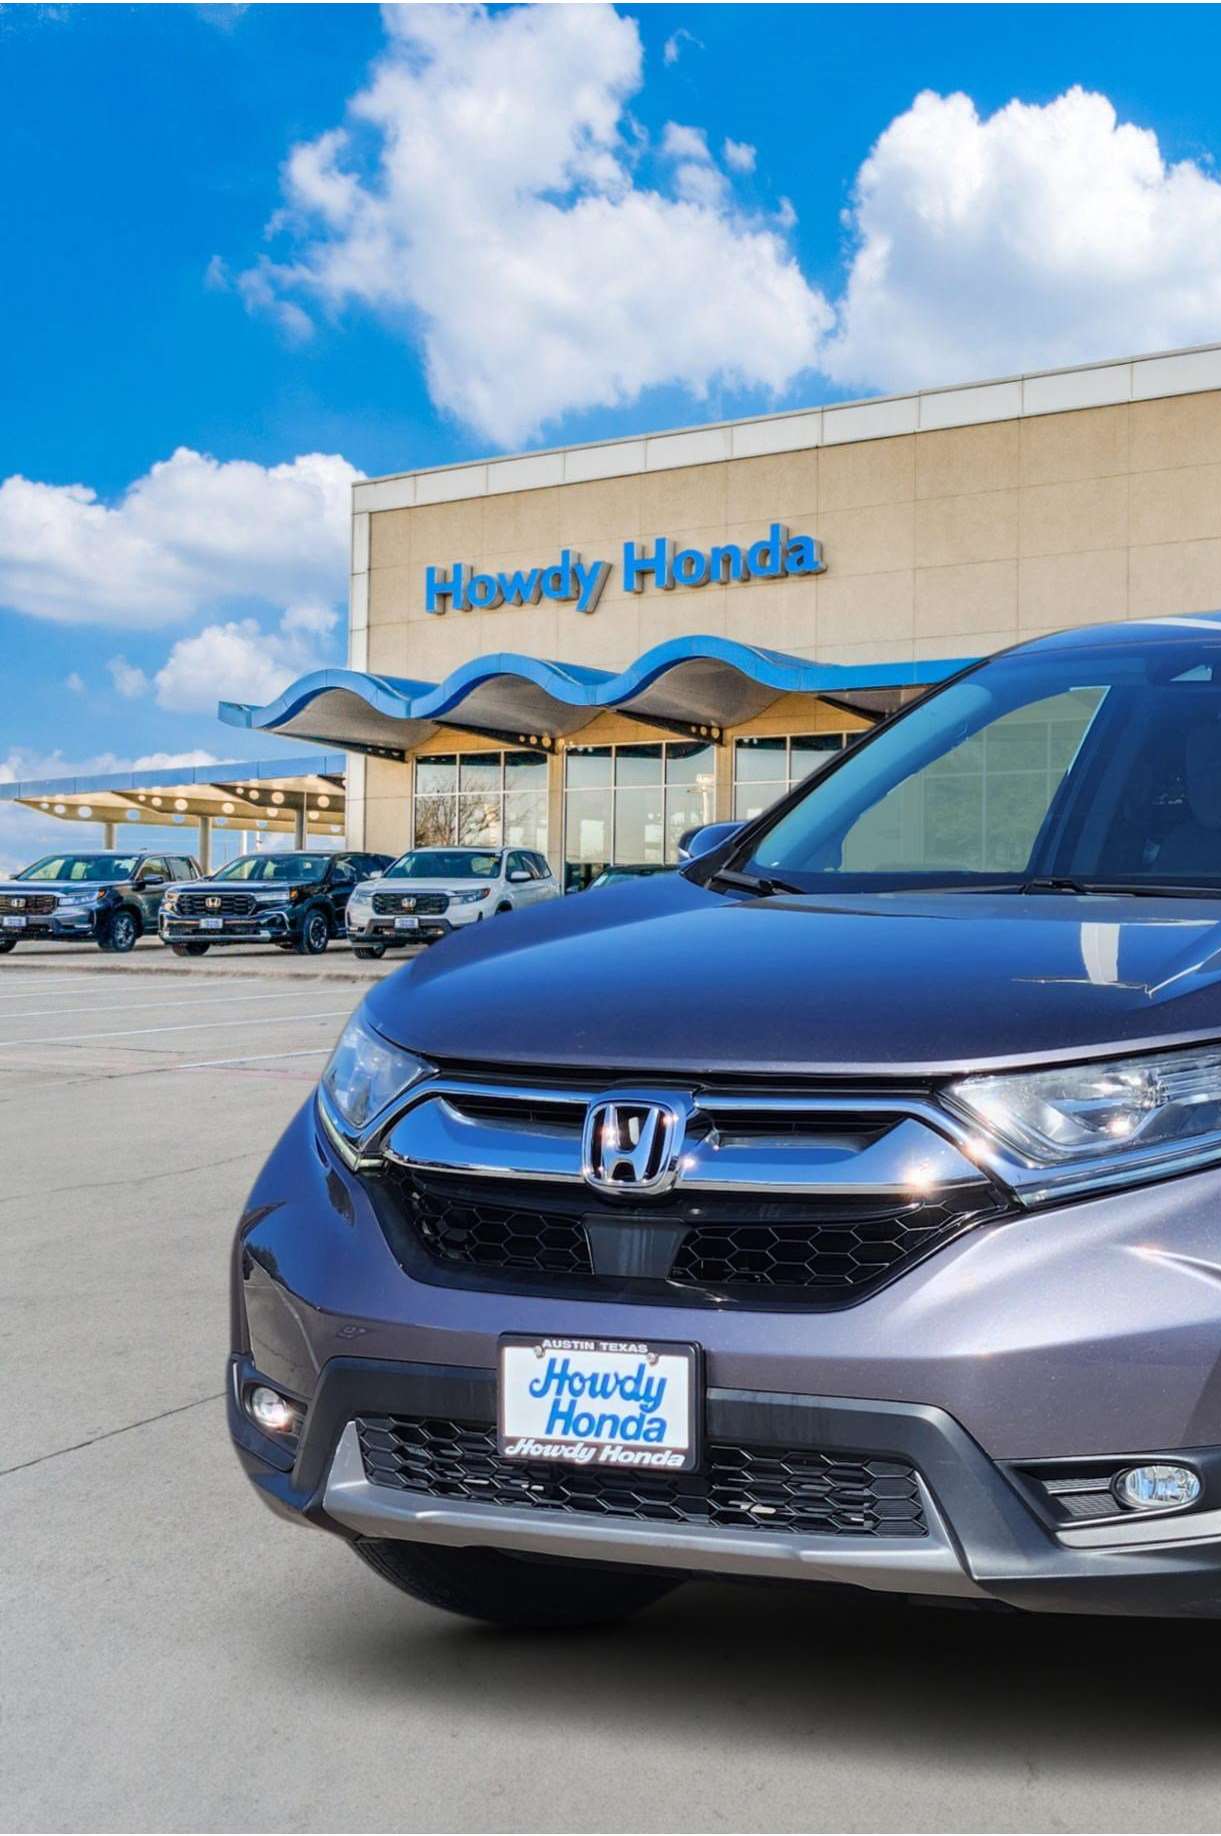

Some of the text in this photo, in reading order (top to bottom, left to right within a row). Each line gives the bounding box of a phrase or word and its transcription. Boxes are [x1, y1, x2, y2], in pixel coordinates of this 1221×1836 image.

[425, 523, 827, 615] Howdy Honda
[542, 1339, 648, 1353] AUSTIN TEXAS
[529, 1358, 667, 1414] Howdy
[545, 1398, 667, 1443] Honda
[504, 1438, 685, 1468] Howdy Honda
